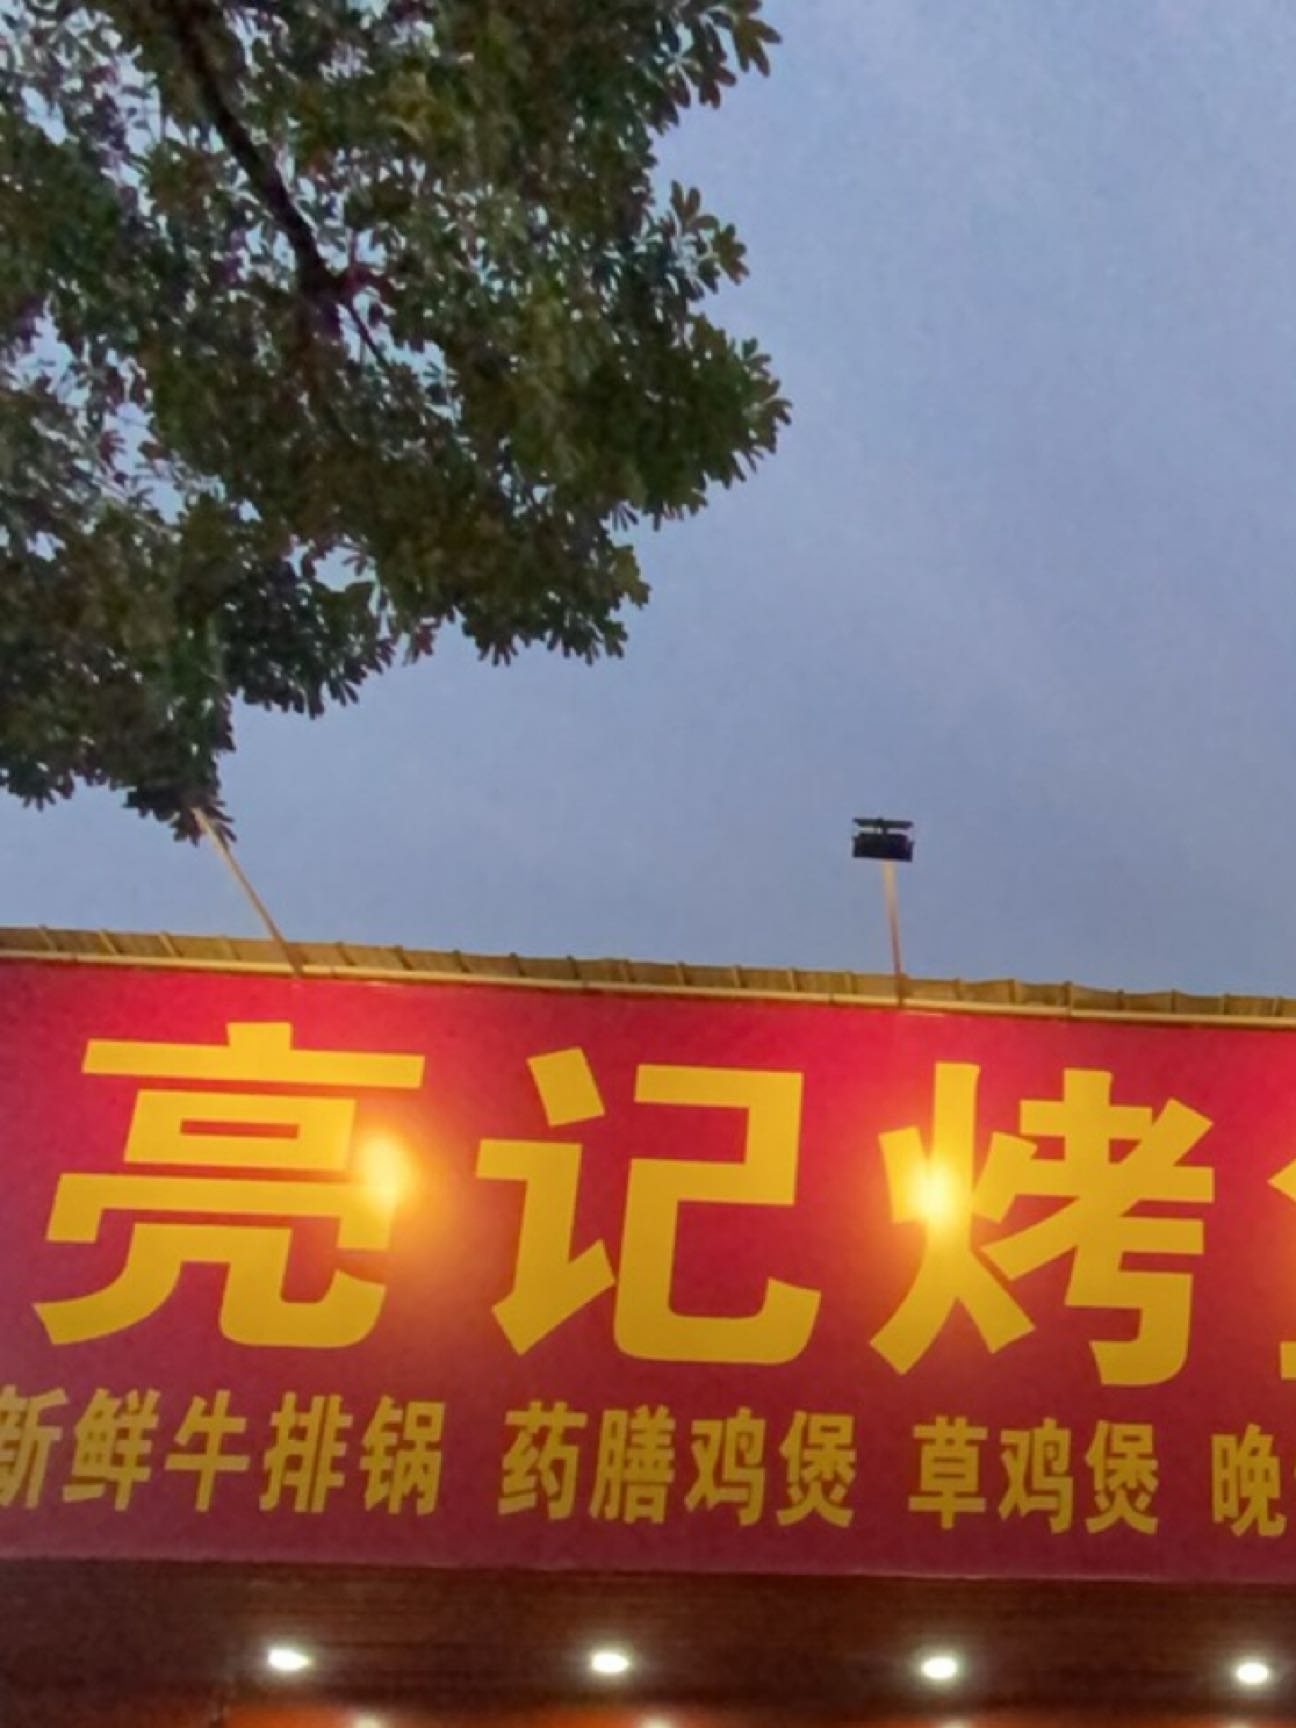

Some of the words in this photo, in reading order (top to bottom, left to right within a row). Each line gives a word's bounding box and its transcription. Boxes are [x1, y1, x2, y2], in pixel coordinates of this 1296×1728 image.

[0, 1384, 446, 1515] 新鲜牛排锅
[498, 1399, 858, 1527] 药膳鸡煲
[907, 1414, 1160, 1535] 草鸡煲
